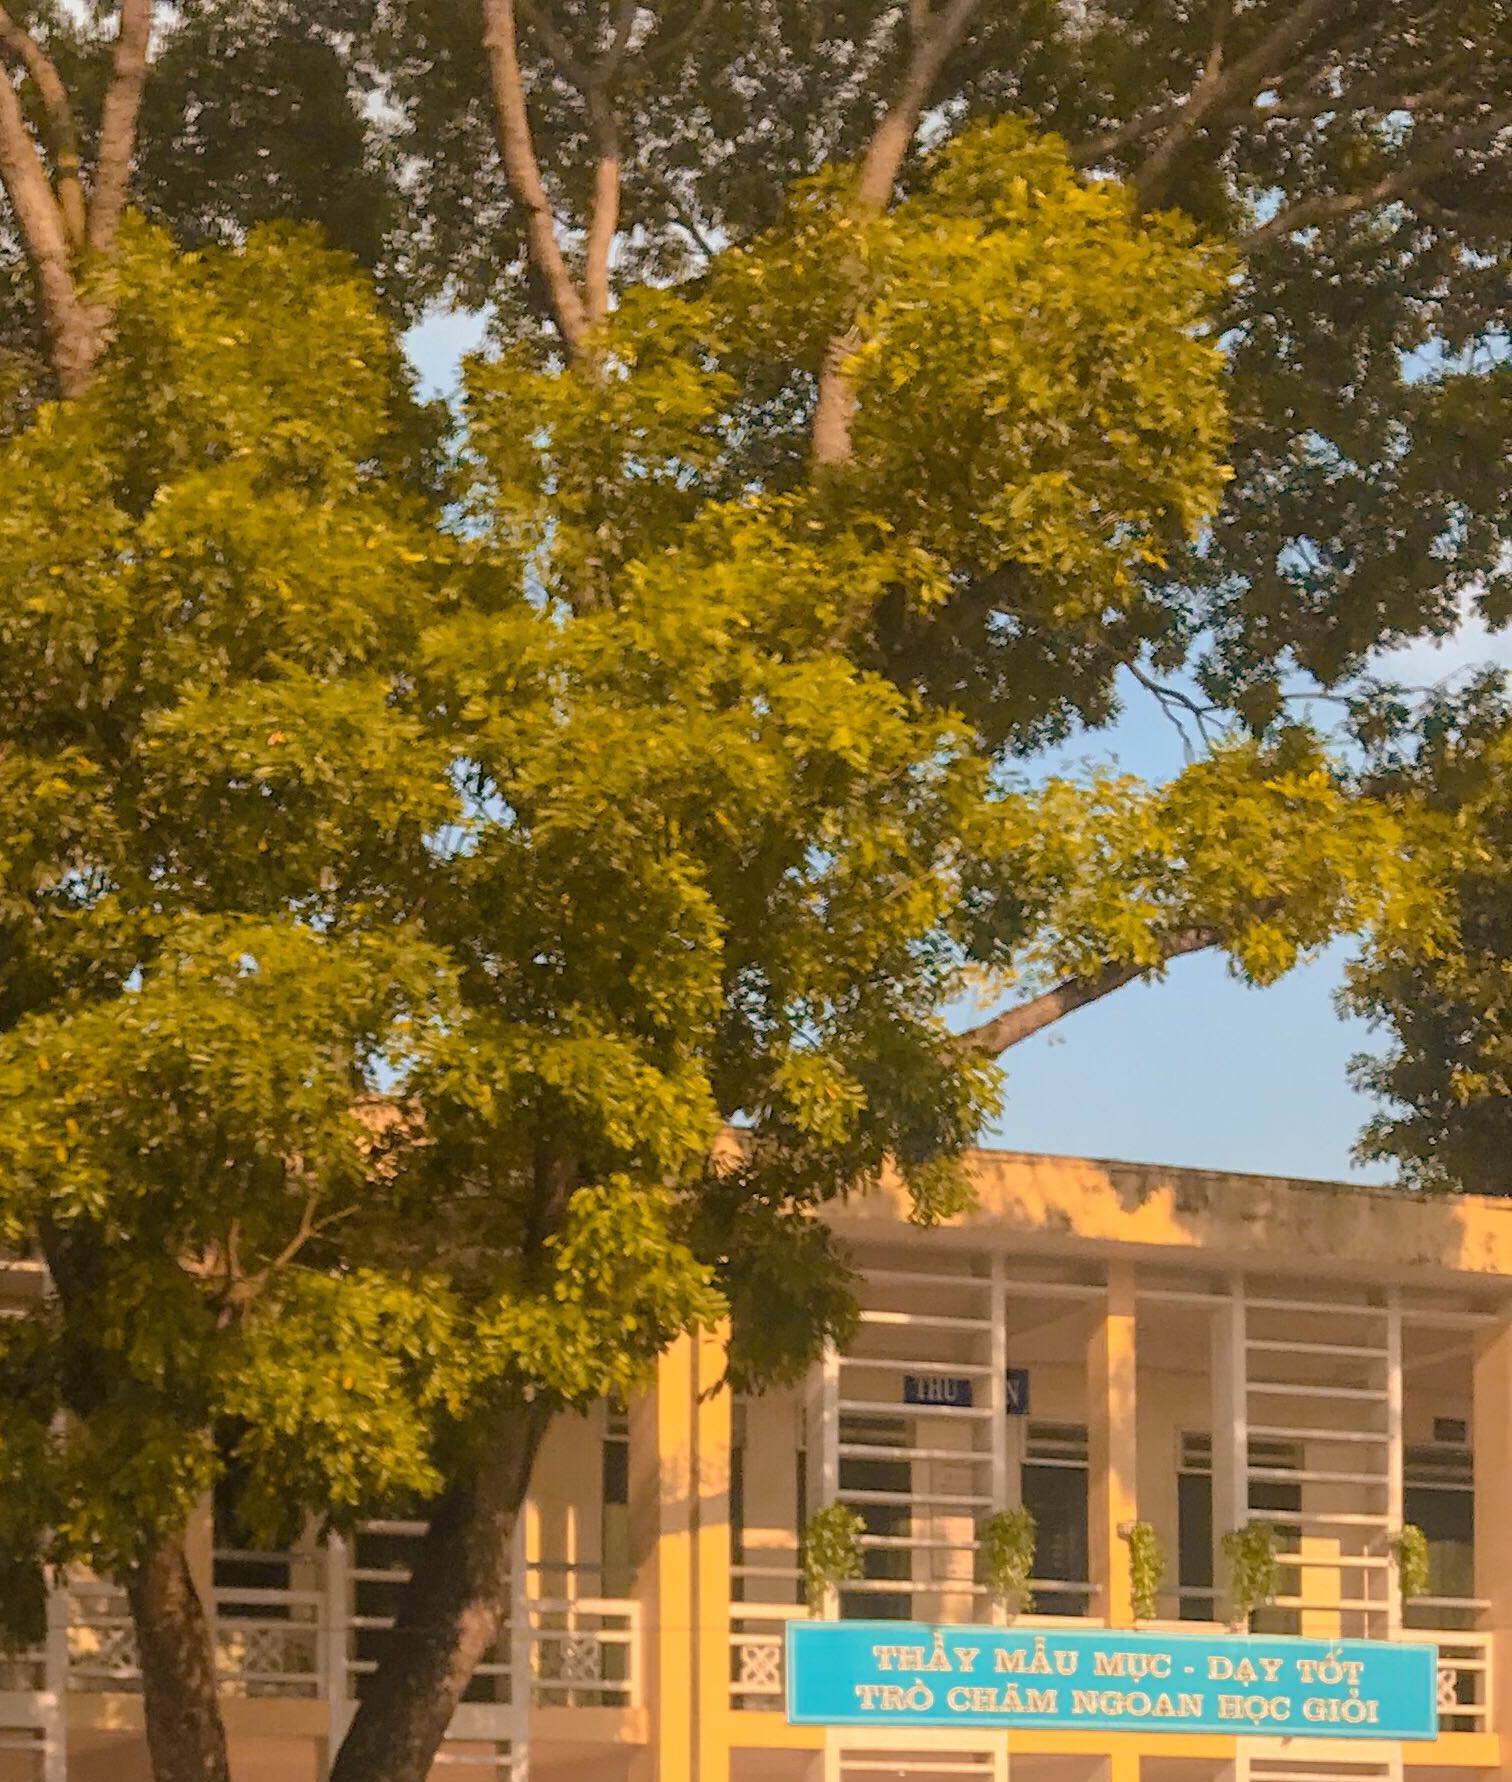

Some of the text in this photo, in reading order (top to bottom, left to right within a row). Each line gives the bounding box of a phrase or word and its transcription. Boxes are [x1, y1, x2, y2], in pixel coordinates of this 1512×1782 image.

[1207, 1656, 1284, 1688] DẠY
[1296, 1648, 1364, 1685] TỐT
[855, 1677, 934, 1711] TRÒ
[1072, 1690, 1204, 1717] NGOAN
[1217, 1694, 1291, 1726] HỌC
